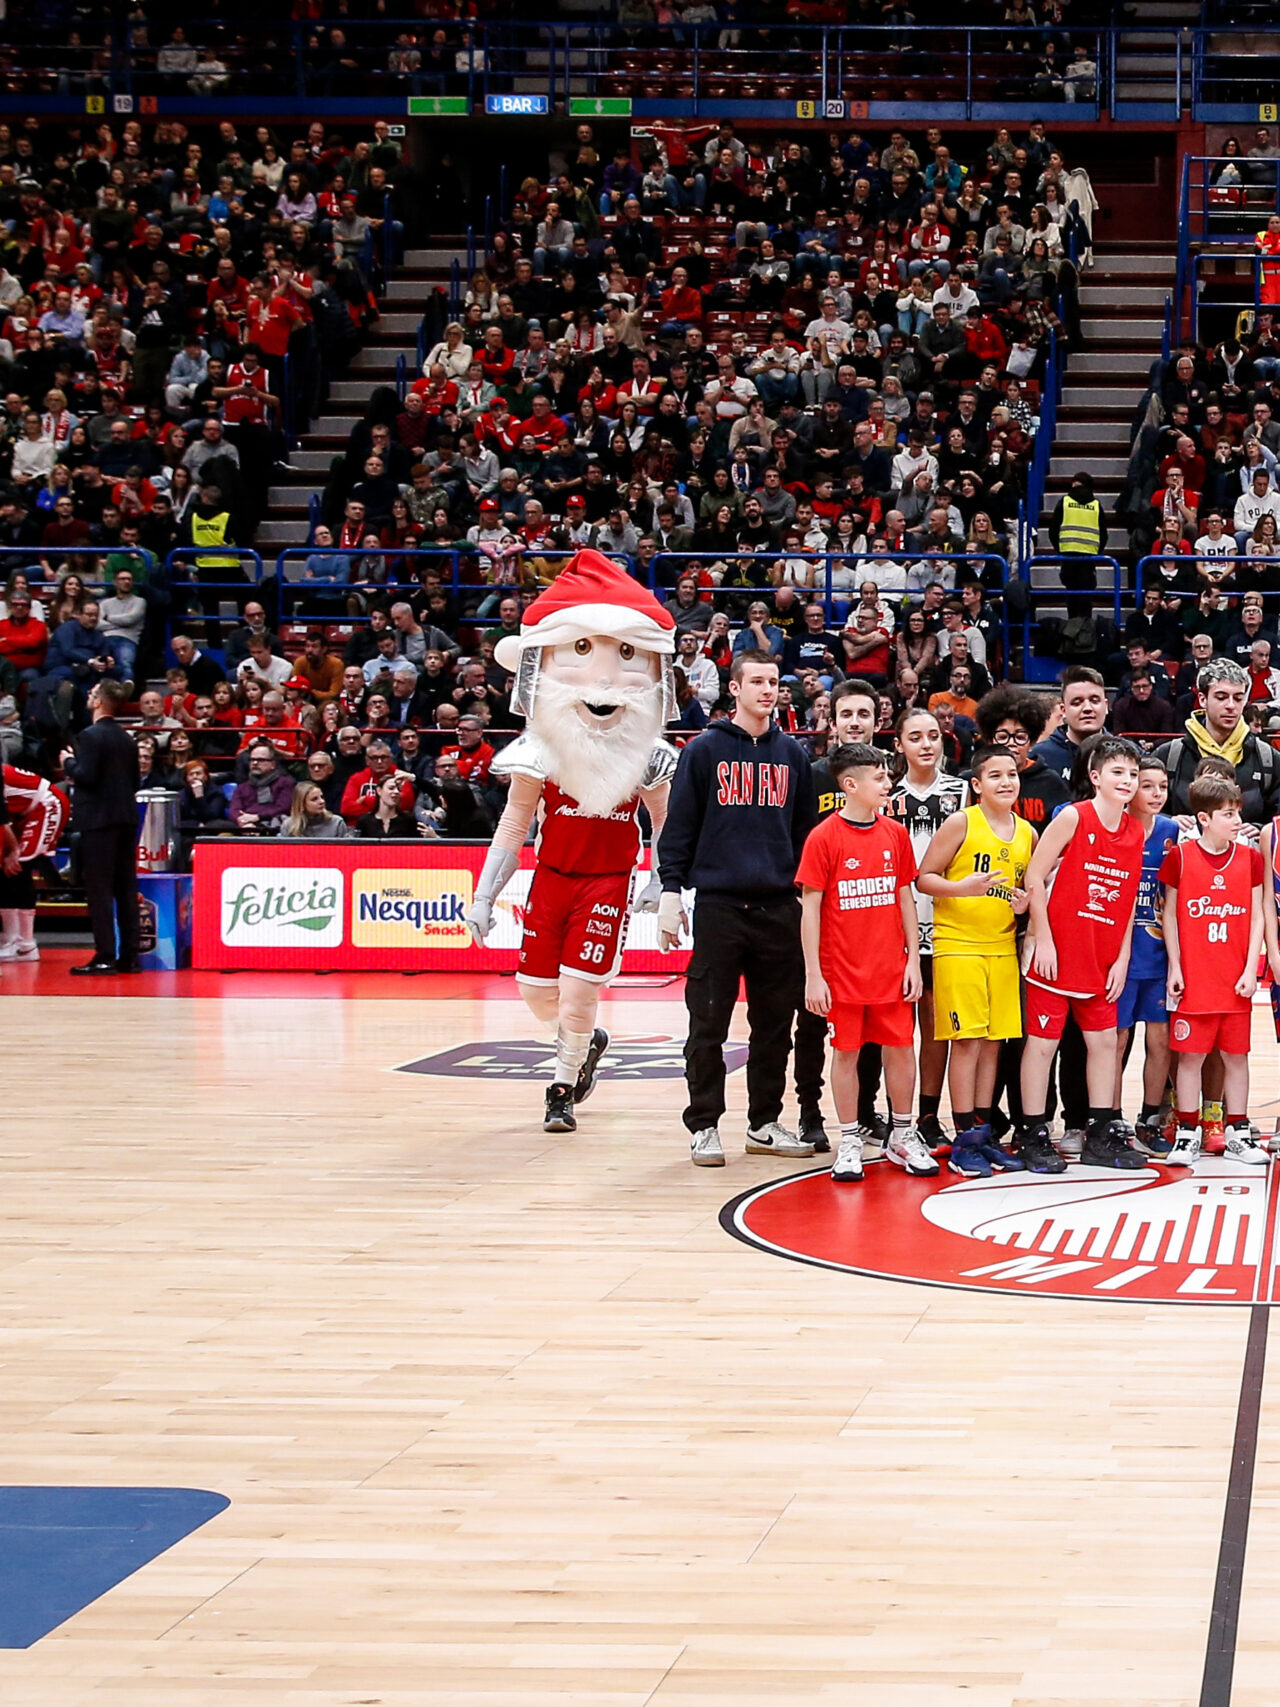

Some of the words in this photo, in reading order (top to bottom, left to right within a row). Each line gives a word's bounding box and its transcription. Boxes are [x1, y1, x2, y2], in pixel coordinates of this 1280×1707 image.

[502, 98, 531, 112] BAR
[828, 103, 842, 115] 20
[1248, 506, 1274, 519] POO
[717, 761, 754, 806] SAN
[973, 852, 991, 873] 18
[226, 881, 337, 934] felicia
[359, 892, 467, 928] Nesquik
[592, 903, 619, 918] AON
[840, 896, 871, 911] SEVESO
[1187, 896, 1241, 918] Sanfru
[424, 923, 466, 936] Snack
[1208, 922, 1229, 942] 84
[580, 941, 605, 964] 36
[1192, 1185, 1250, 1195] 19
